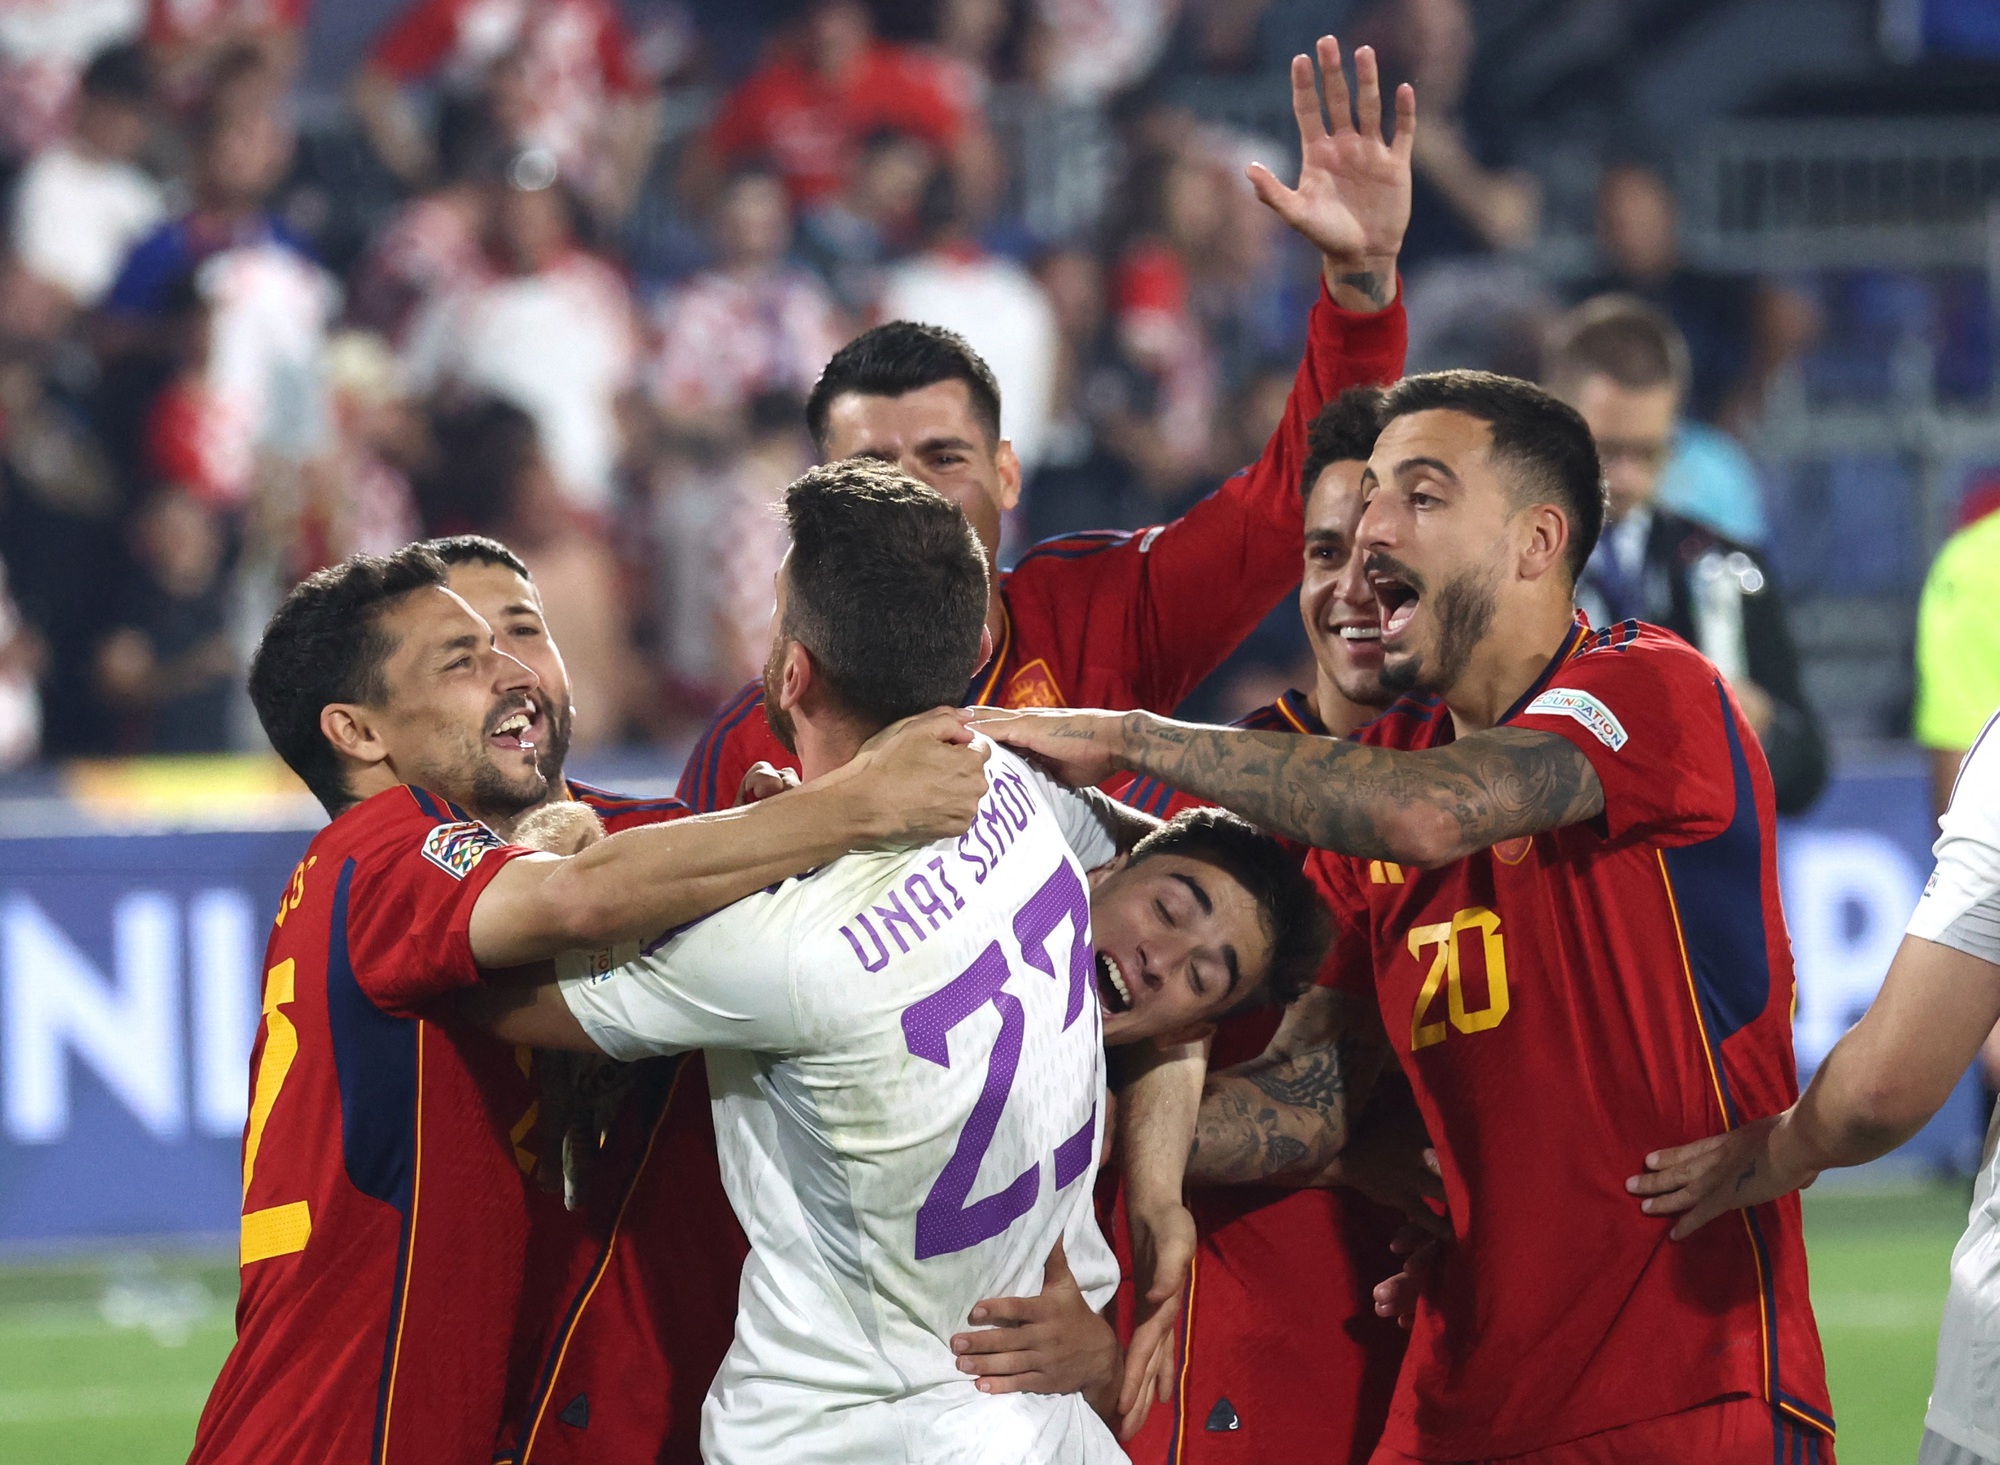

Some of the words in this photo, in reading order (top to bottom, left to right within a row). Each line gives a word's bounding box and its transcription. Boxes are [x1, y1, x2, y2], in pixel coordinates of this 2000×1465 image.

[1533, 695, 1623, 747] FOUNDATION
[838, 855, 966, 974] UNAI
[1407, 906, 1511, 1051] 20
